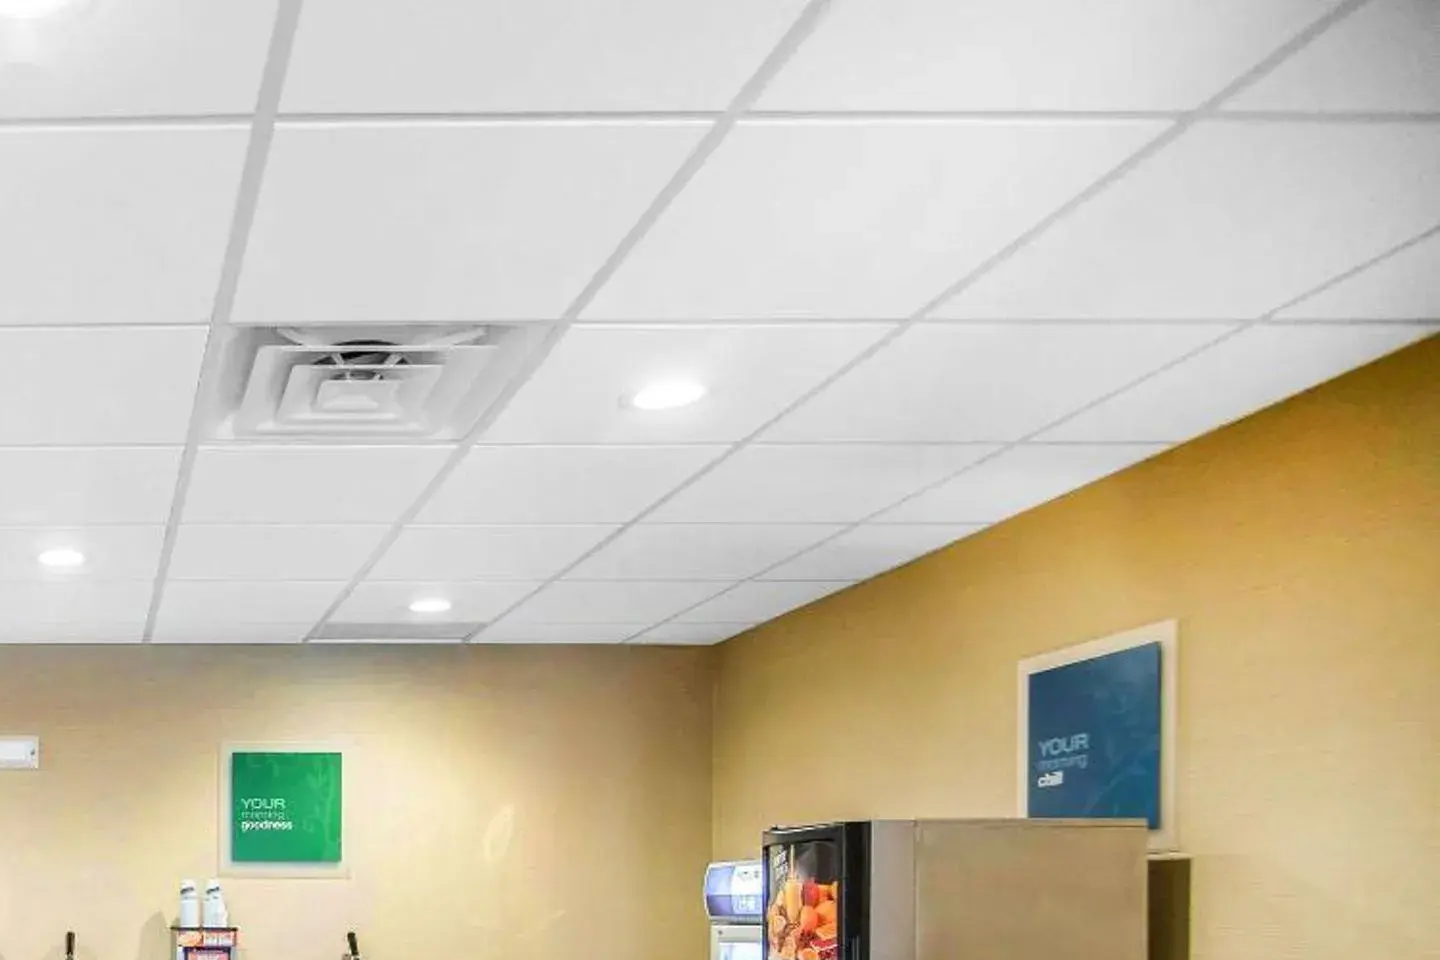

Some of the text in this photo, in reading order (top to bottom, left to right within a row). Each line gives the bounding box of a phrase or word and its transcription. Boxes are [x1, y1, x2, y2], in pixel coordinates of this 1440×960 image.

[1038, 733, 1089, 757] YOUR
[1037, 755, 1088, 769] morning
[1038, 770, 1064, 787] chill
[241, 798, 286, 809] YOUR
[241, 820, 293, 832] goodness
